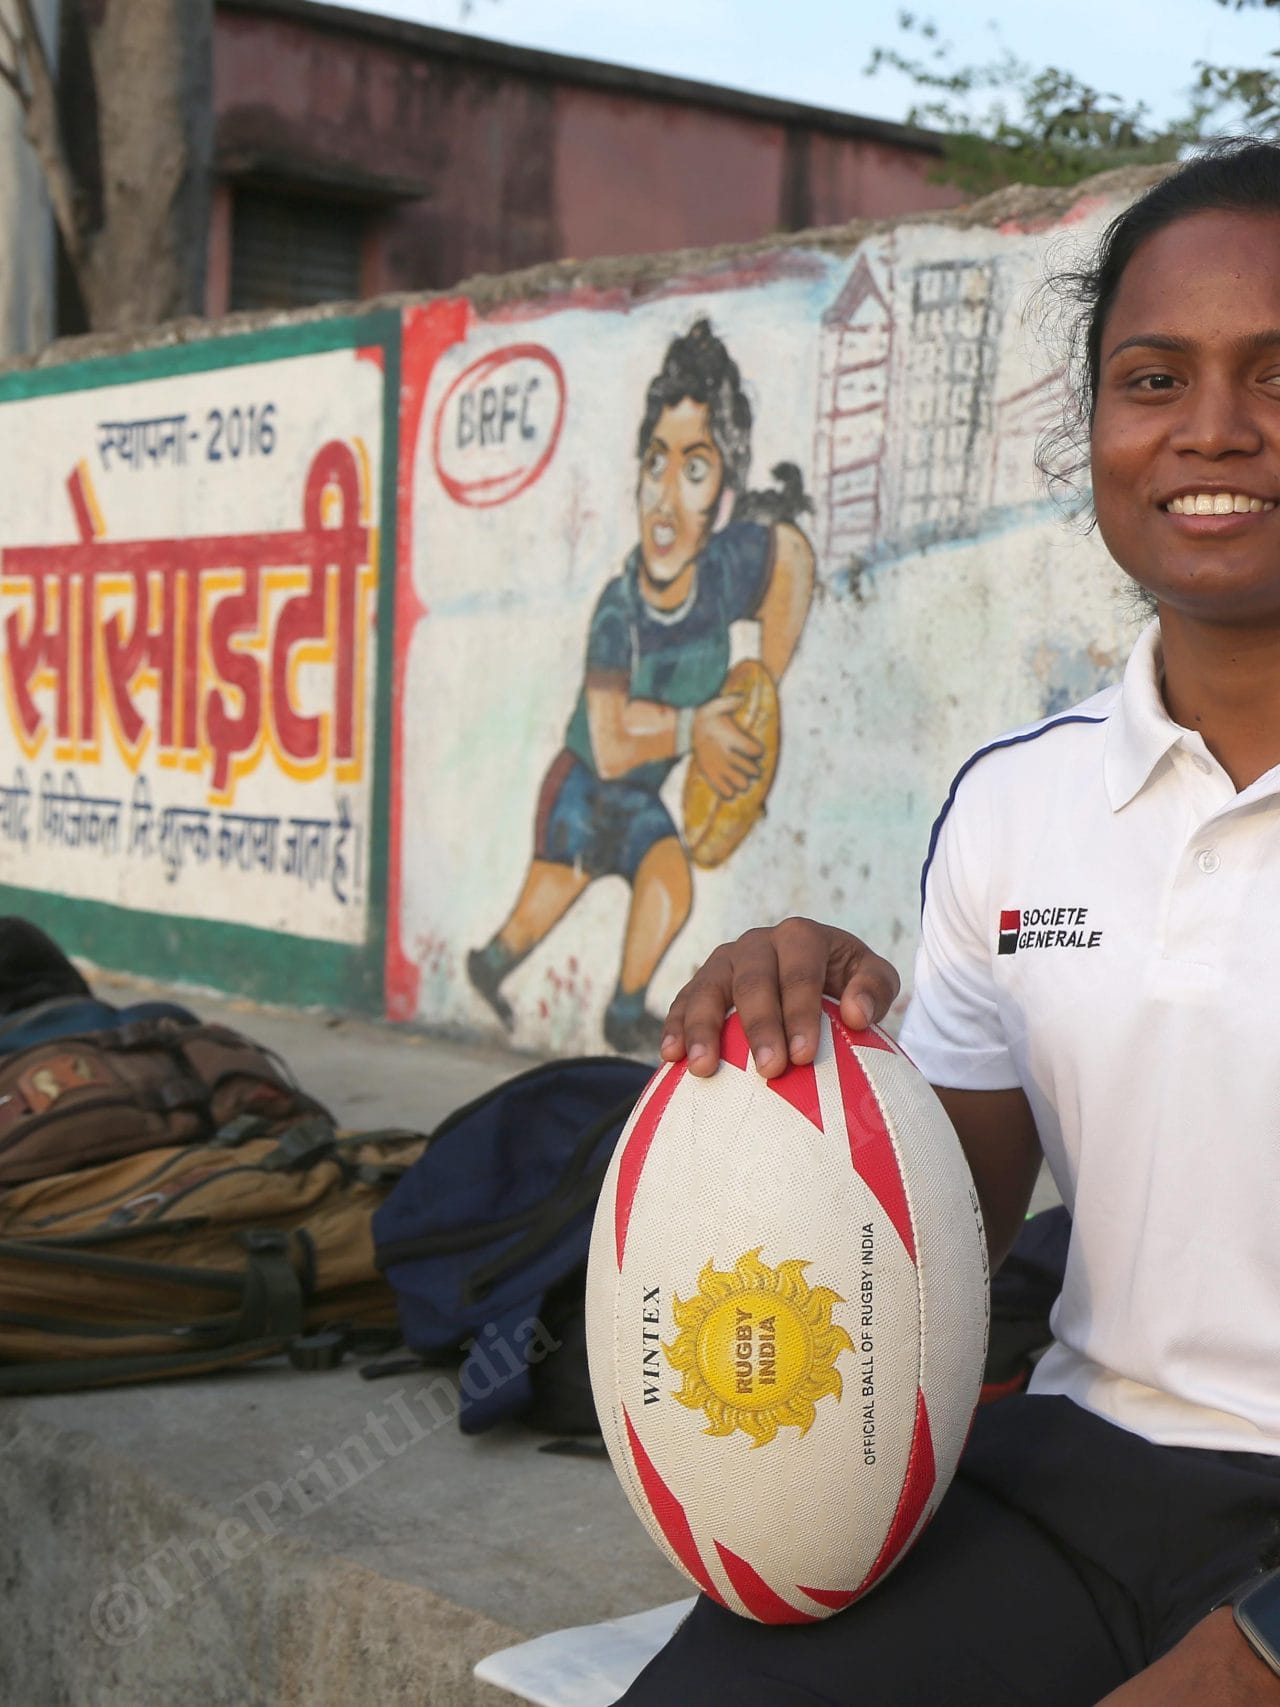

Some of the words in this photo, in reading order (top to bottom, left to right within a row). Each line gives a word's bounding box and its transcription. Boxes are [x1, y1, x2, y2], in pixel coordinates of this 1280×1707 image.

[457, 376, 540, 450] BRFC
[1018, 930, 1103, 949] GENERALE
[1022, 907, 1088, 927] SOCIETE
[861, 1222, 875, 1265] INDIA
[861, 1270, 874, 1326] RUGBY
[642, 1286, 661, 1406] WINTEX
[735, 1306, 753, 1394] RUGBY
[758, 1315, 776, 1385] INDIA
[861, 1331, 874, 1353] OF
[861, 1356, 875, 1397] BALL
[863, 1400, 876, 1466] OFFICIAL
